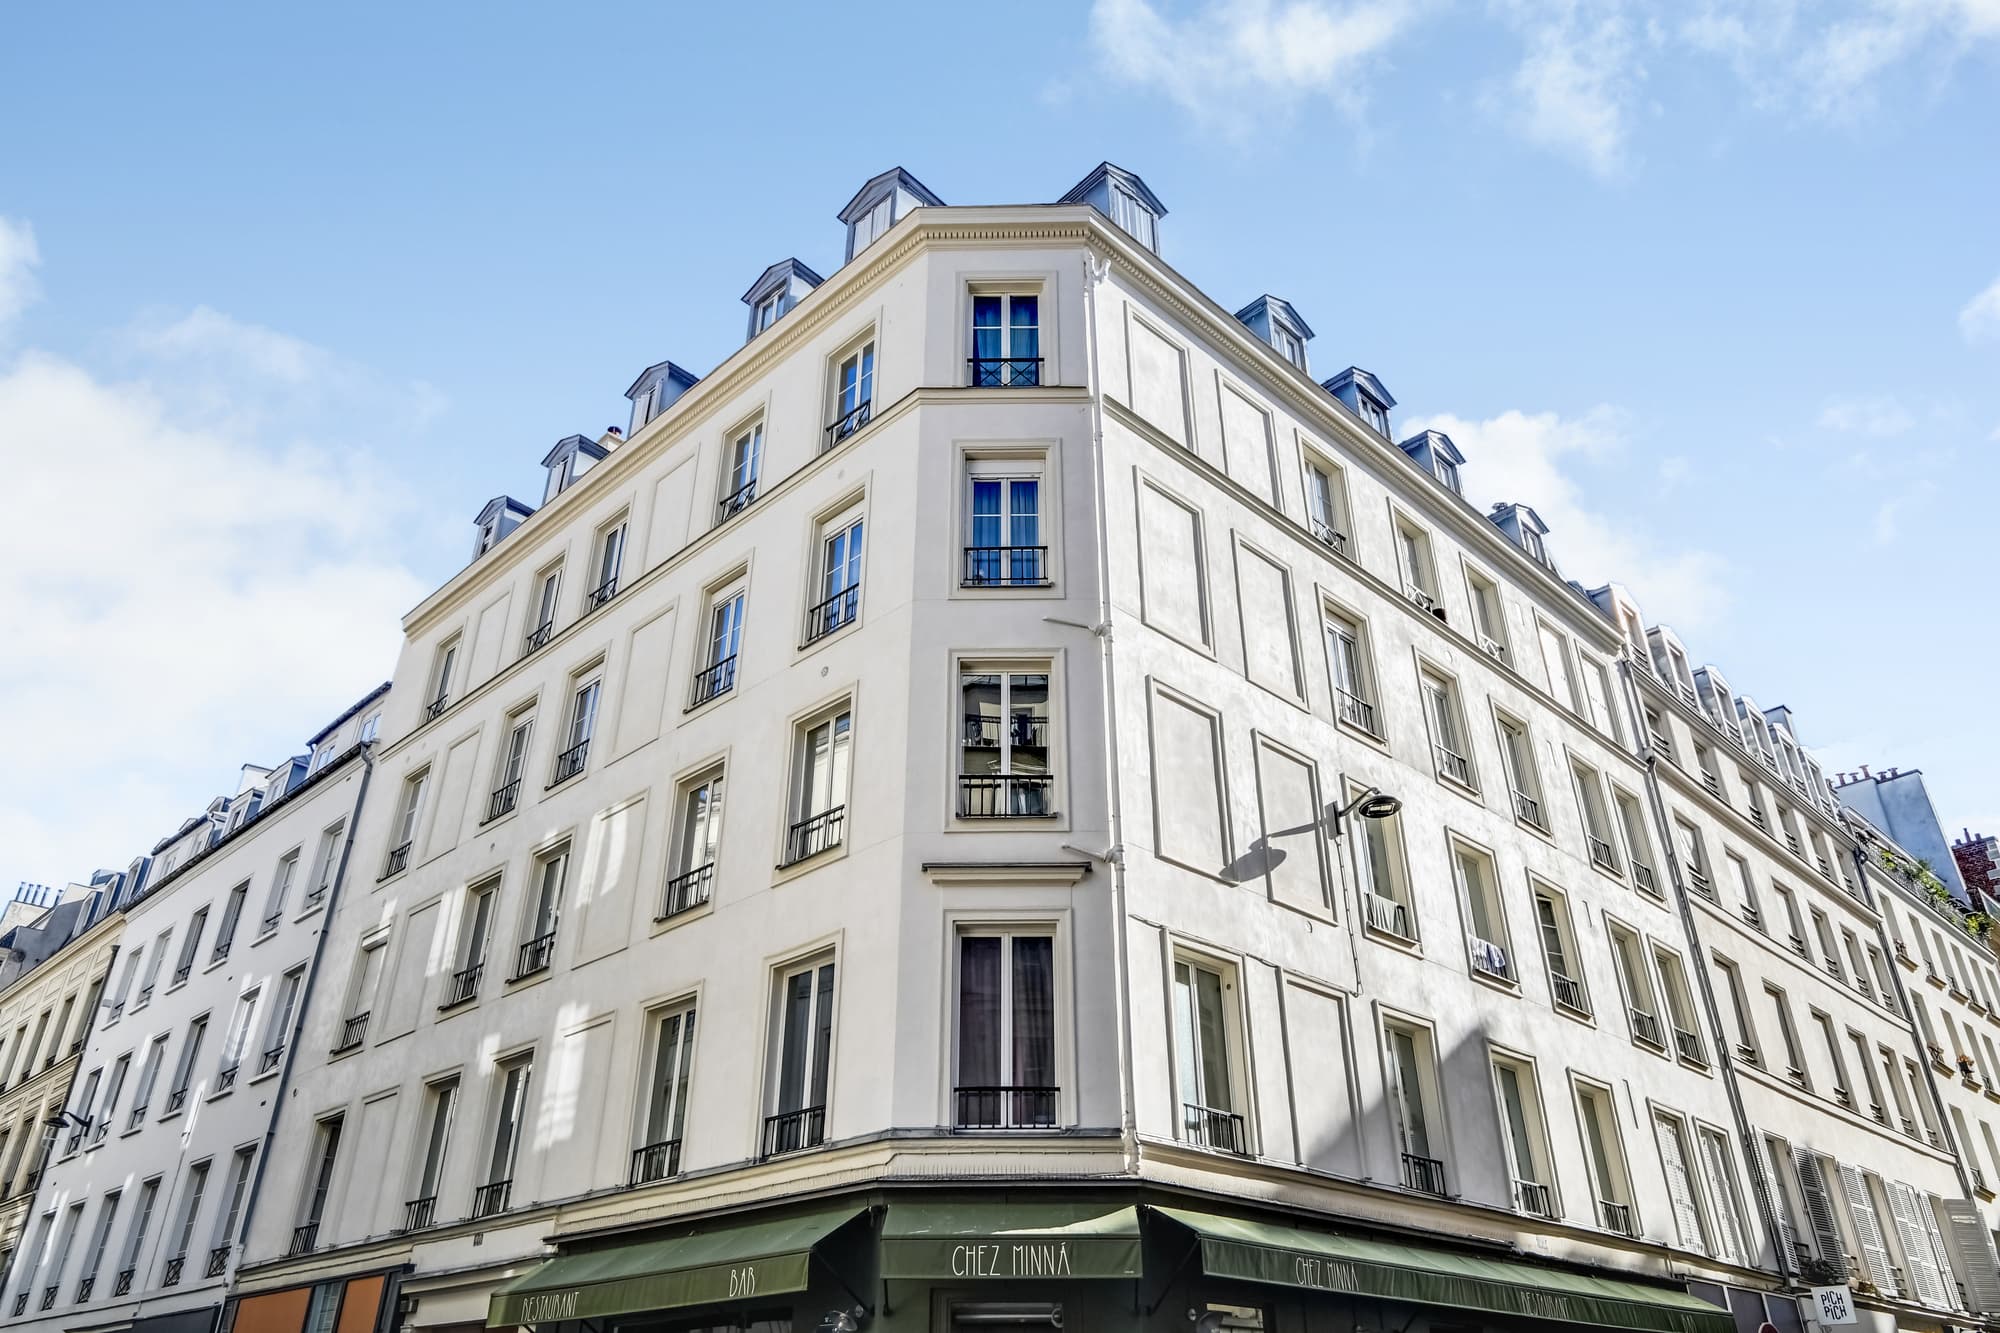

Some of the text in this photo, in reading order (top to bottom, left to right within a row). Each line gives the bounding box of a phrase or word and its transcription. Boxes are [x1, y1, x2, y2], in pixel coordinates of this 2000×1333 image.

[952, 1242, 1070, 1276] CHEZ MINNÁ
[1296, 1257, 1323, 1288] CHEZ
[521, 1267, 755, 1321] RESTAURANT BAR
[1820, 1291, 1844, 1306] PICH
